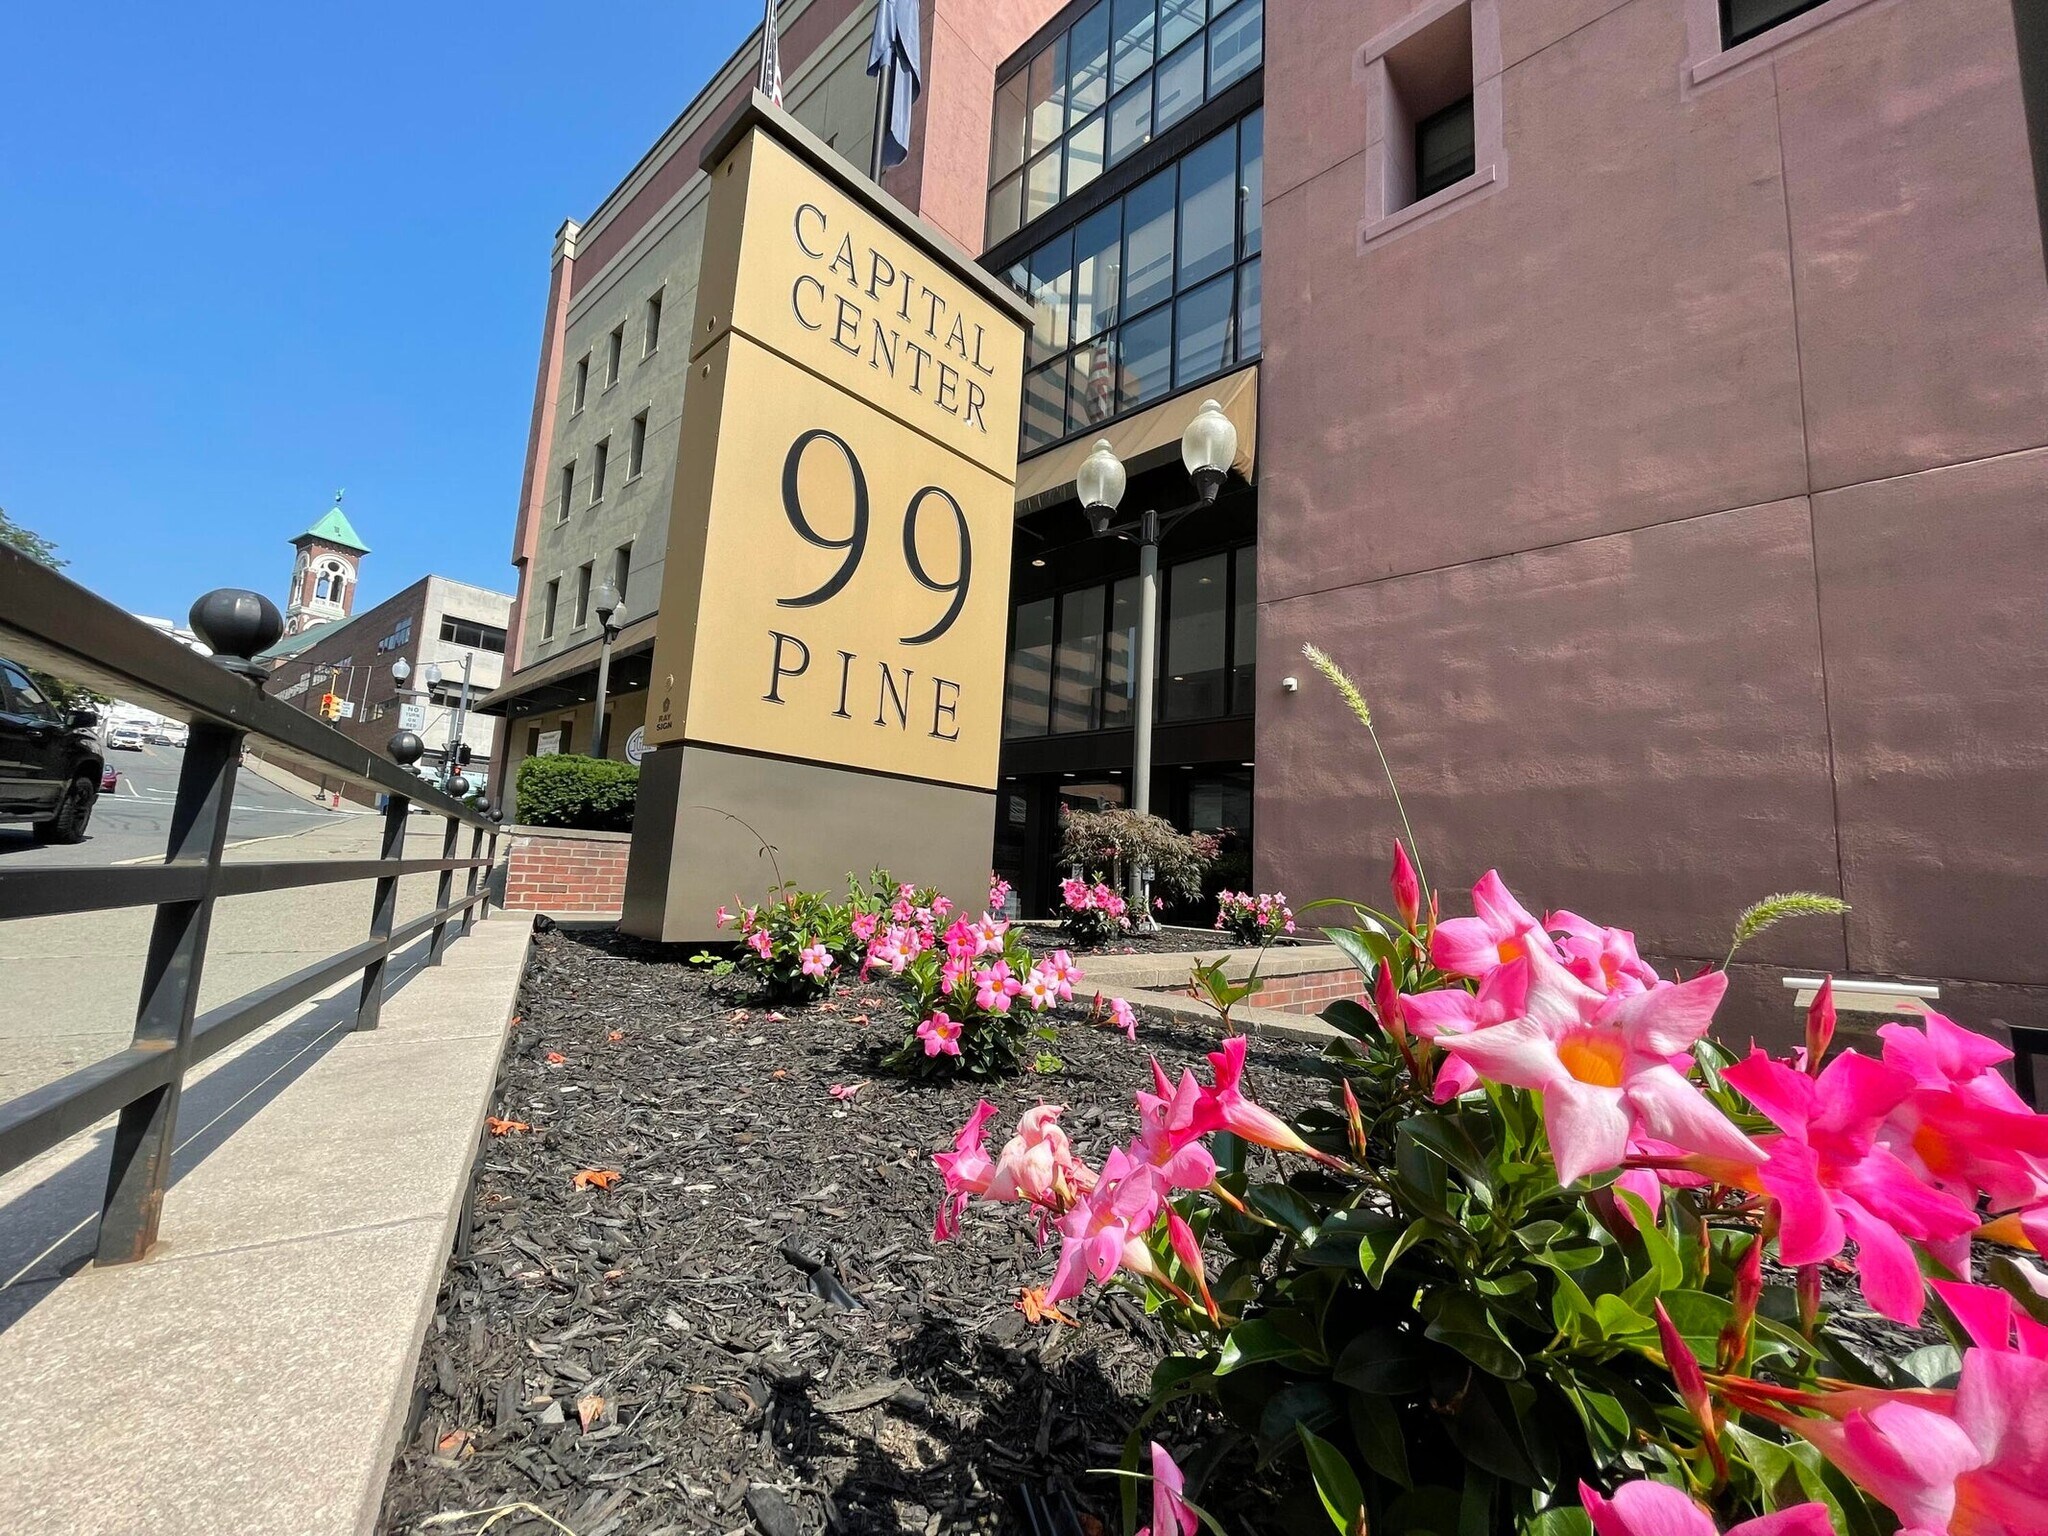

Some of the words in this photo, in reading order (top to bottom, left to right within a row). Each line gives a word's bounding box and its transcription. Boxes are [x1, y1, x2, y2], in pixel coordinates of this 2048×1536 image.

[791, 274, 988, 434] CENTER
[793, 203, 995, 377] CAPITAL
[776, 428, 972, 646] 99
[656, 722, 673, 731] SIGN
[658, 713, 672, 722] RAY
[761, 629, 961, 742] PINE
